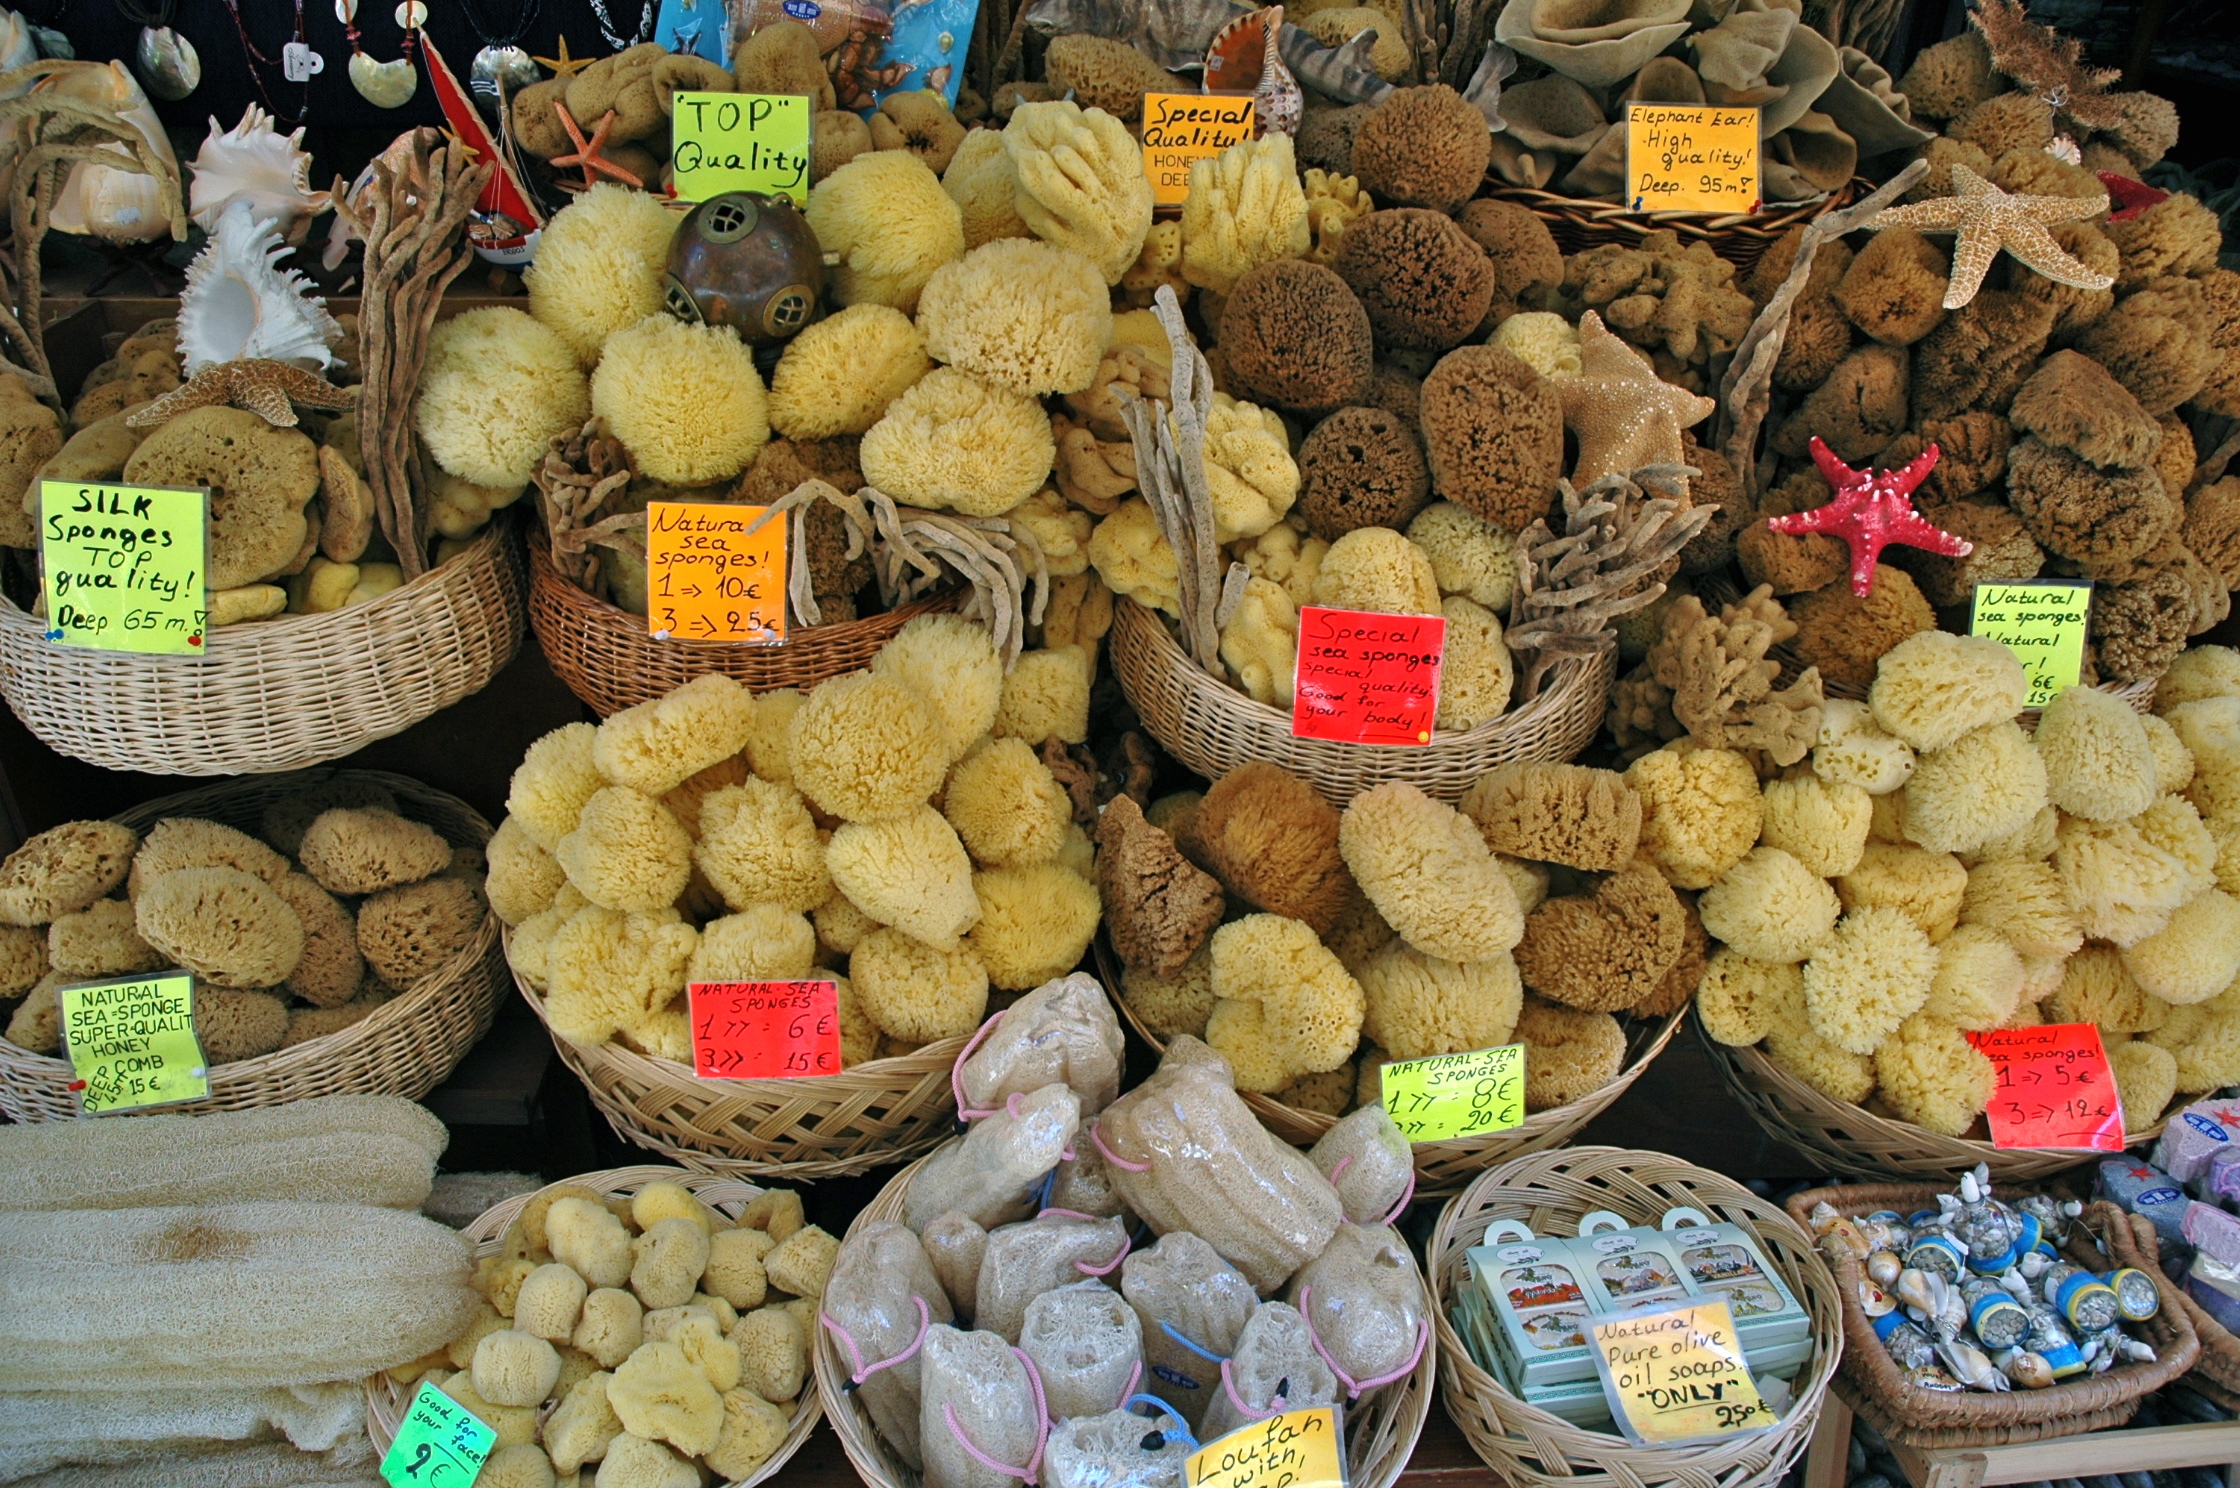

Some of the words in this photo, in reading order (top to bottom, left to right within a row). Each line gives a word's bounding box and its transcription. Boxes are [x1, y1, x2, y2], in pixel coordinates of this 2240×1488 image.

[1151, 98, 1253, 129] Special
[1630, 107, 1703, 127] Elephant
[1710, 112, 1754, 128] Ear!
[1647, 128, 1692, 155] High
[674, 141, 807, 188] Quality
[72, 489, 153, 520] SILK
[46, 514, 173, 552] Sponges
[680, 535, 731, 552] sea
[83, 547, 152, 568] TOP
[655, 551, 769, 575] sponges!
[1982, 588, 2075, 606] Natural
[58, 604, 108, 635] Deep
[1308, 613, 1420, 644] Special
[1977, 612, 2006, 622] sea
[1302, 661, 1372, 679] special
[1309, 647, 1349, 660] sea
[1359, 650, 1441, 673] sponges
[1299, 685, 1347, 701] Good
[1357, 695, 1385, 707] for
[1300, 705, 1348, 720] your
[1363, 711, 1427, 731] body!
[81, 984, 164, 1007] NATURAL
[730, 996, 812, 1014] SPONGES
[91, 1037, 150, 1058] HONEY
[1973, 1030, 2058, 1048] Natural
[115, 1055, 164, 1075] COMB
[2022, 1044, 2100, 1064] sponges!
[1427, 1064, 1508, 1085] SPONGES
[83, 1065, 109, 1113] DEEP
[1599, 1309, 1695, 1341] Natural
[1609, 1346, 1662, 1367] Pure
[1671, 1330, 1726, 1354] olive
[1619, 1362, 1651, 1389] oil
[419, 1392, 453, 1420] Good
[455, 1417, 478, 1437] for
[413, 1410, 442, 1430] your
[451, 1434, 486, 1469] face!
